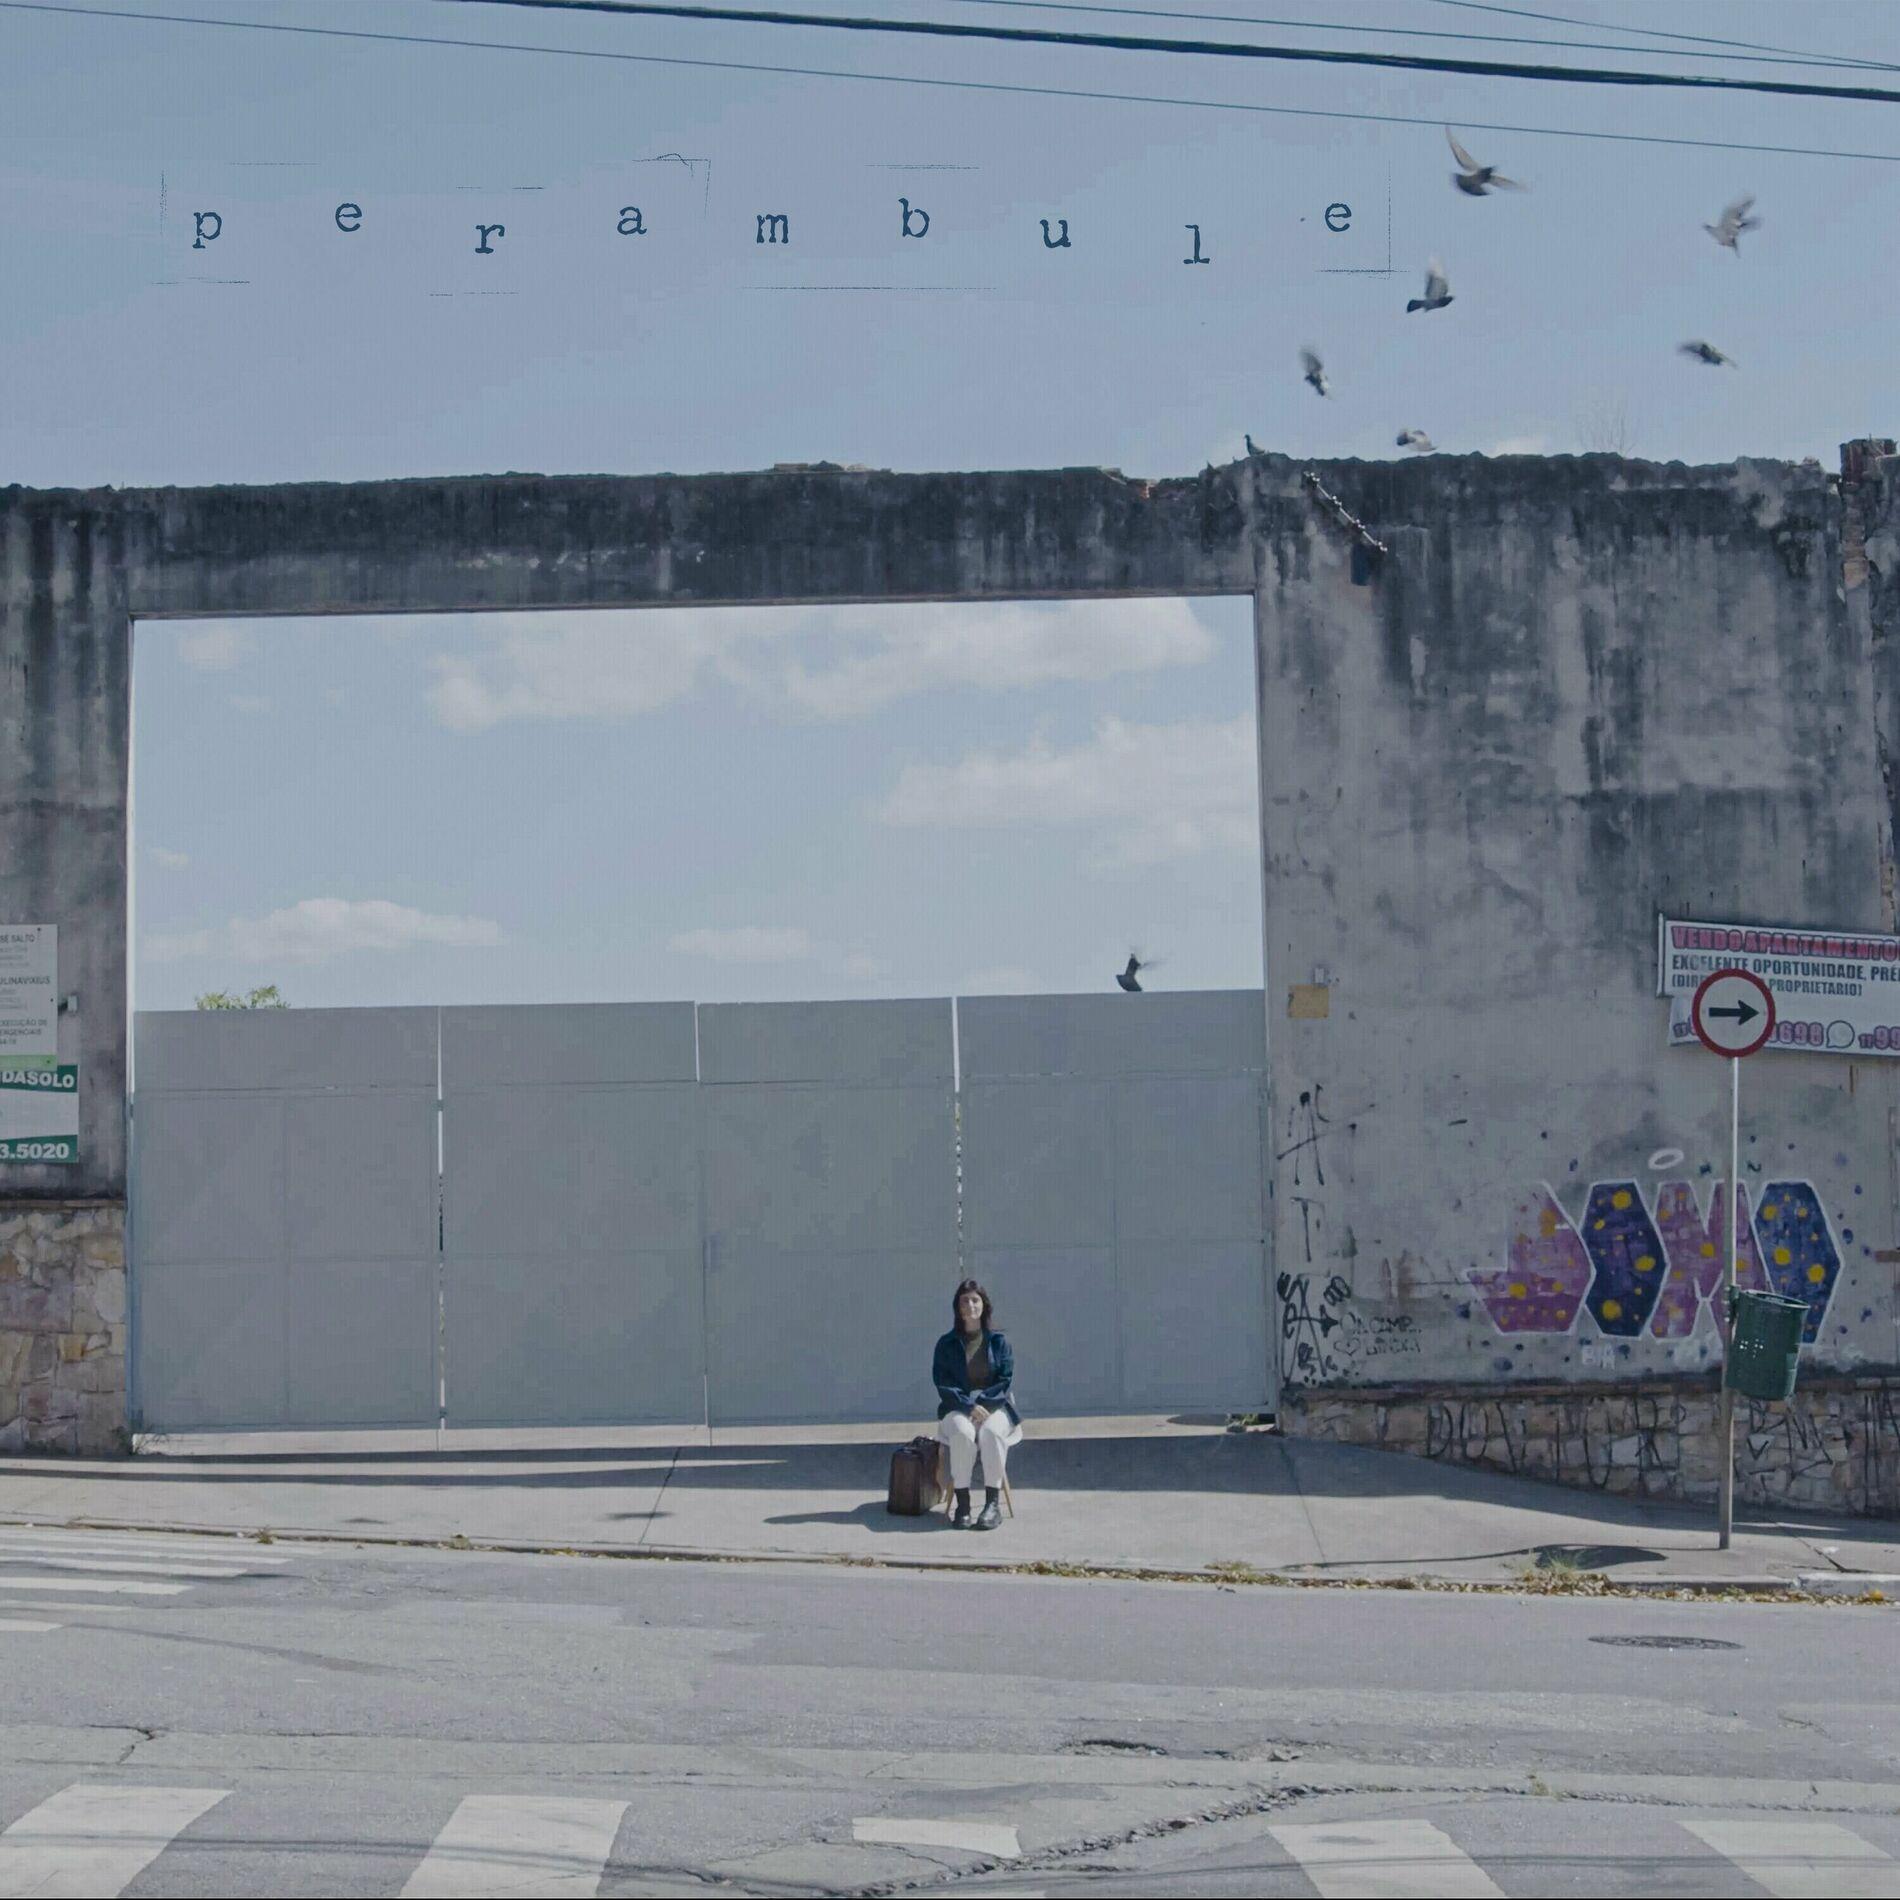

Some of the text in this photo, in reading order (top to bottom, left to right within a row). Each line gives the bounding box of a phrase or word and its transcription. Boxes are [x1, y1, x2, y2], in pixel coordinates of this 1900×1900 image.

[1671, 926, 1742, 952] VENDO
[1871, 965, 1900, 982] PRÉ
[0, 1071, 75, 1088] DASOLO
